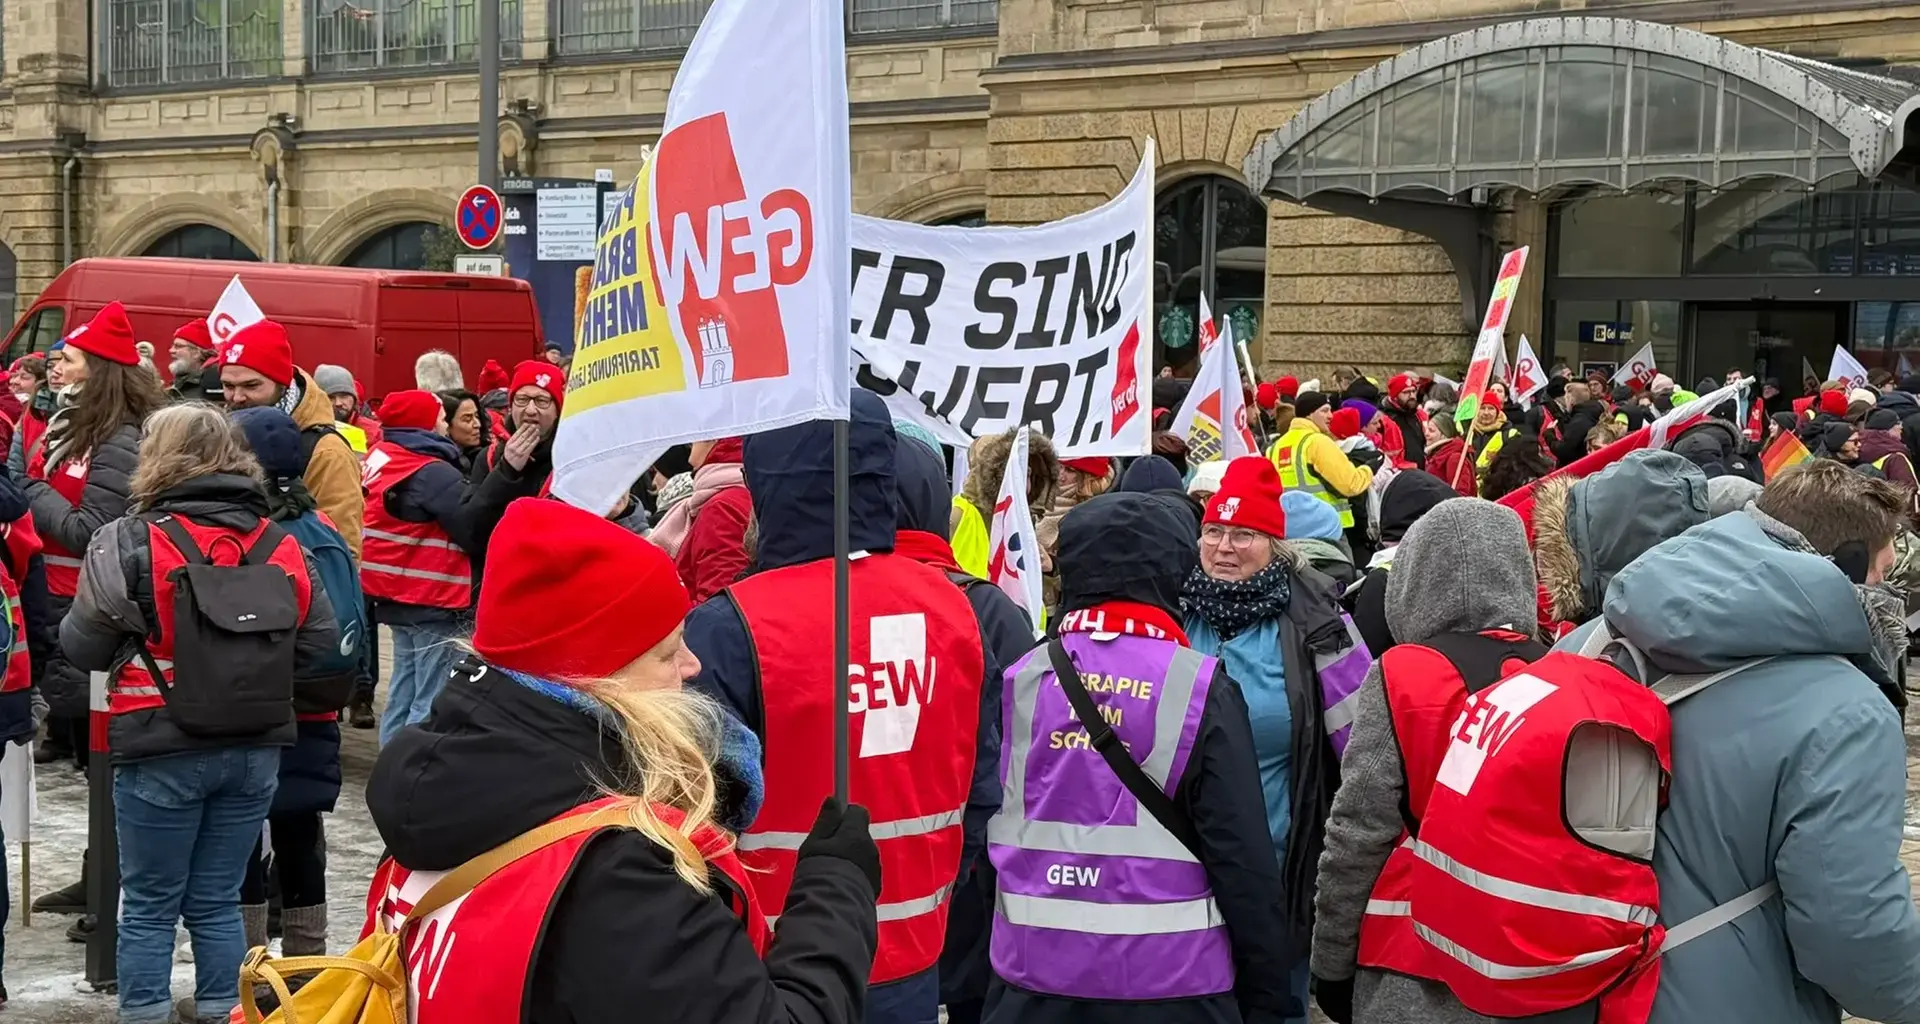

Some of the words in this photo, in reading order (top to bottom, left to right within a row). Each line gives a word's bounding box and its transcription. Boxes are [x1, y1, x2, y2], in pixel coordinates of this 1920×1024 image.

[466, 263, 476, 272] auf
[478, 263, 492, 272] dem
[964, 230, 1136, 350] SIND
[1217, 503, 1240, 515] GEW
[847, 656, 937, 714] GEW
[1053, 670, 1154, 701] ERAPIE
[1067, 701, 1123, 727] TM
[1046, 863, 1101, 888] GEW
